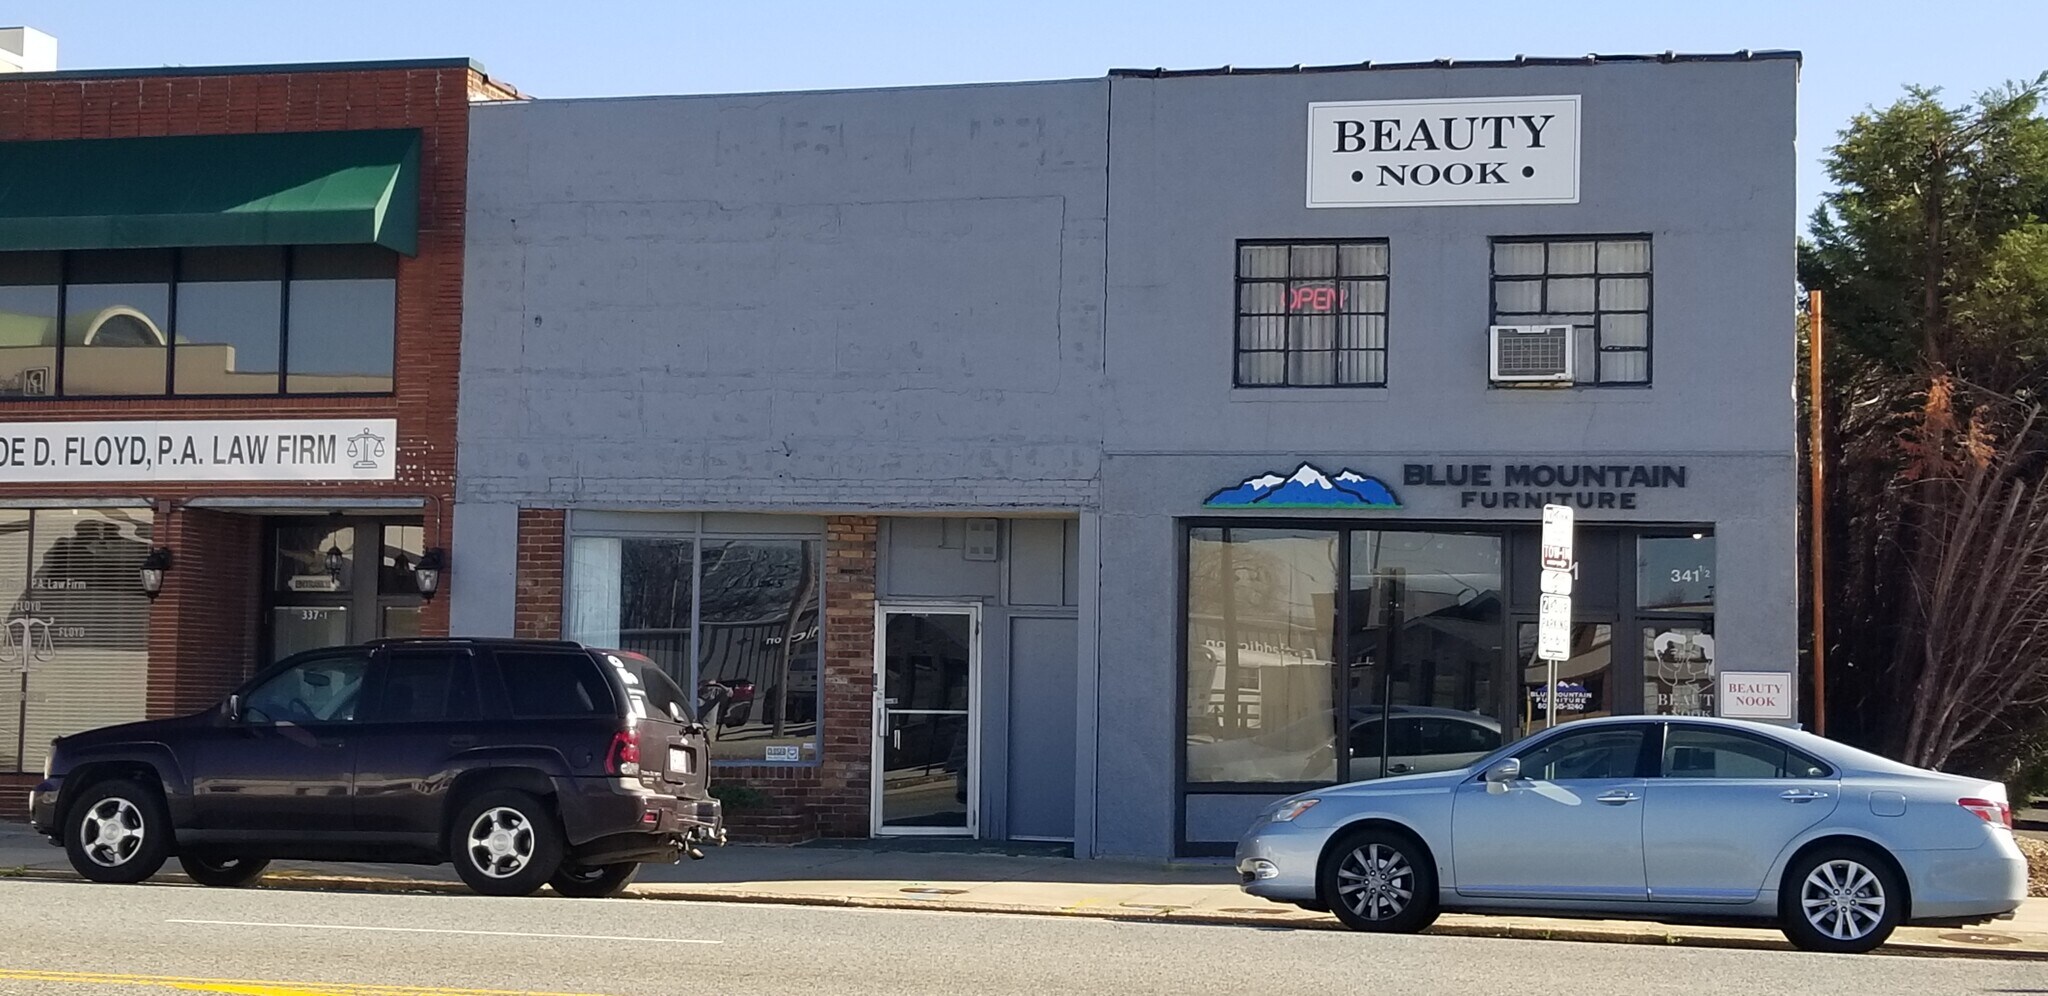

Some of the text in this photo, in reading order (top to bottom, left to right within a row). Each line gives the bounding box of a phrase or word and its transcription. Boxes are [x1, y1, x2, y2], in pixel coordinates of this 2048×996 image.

[1332, 115, 1556, 153] BEAUTY
[1375, 162, 1510, 187] NOOK
[1280, 287, 1345, 310] OPEN
[34, 437, 56, 466] D.
[64, 436, 152, 471] FLOYD,
[157, 435, 204, 466] P.A.
[213, 435, 269, 465] LAW
[276, 434, 337, 465] FIRM
[1403, 464, 1687, 488] BLUE MOUNTAIN
[1460, 491, 1637, 510] FURNITURE
[59, 627, 86, 637] FLOYD
[1728, 683, 1783, 695] BEAUTY
[1736, 696, 1776, 707] NOOK
